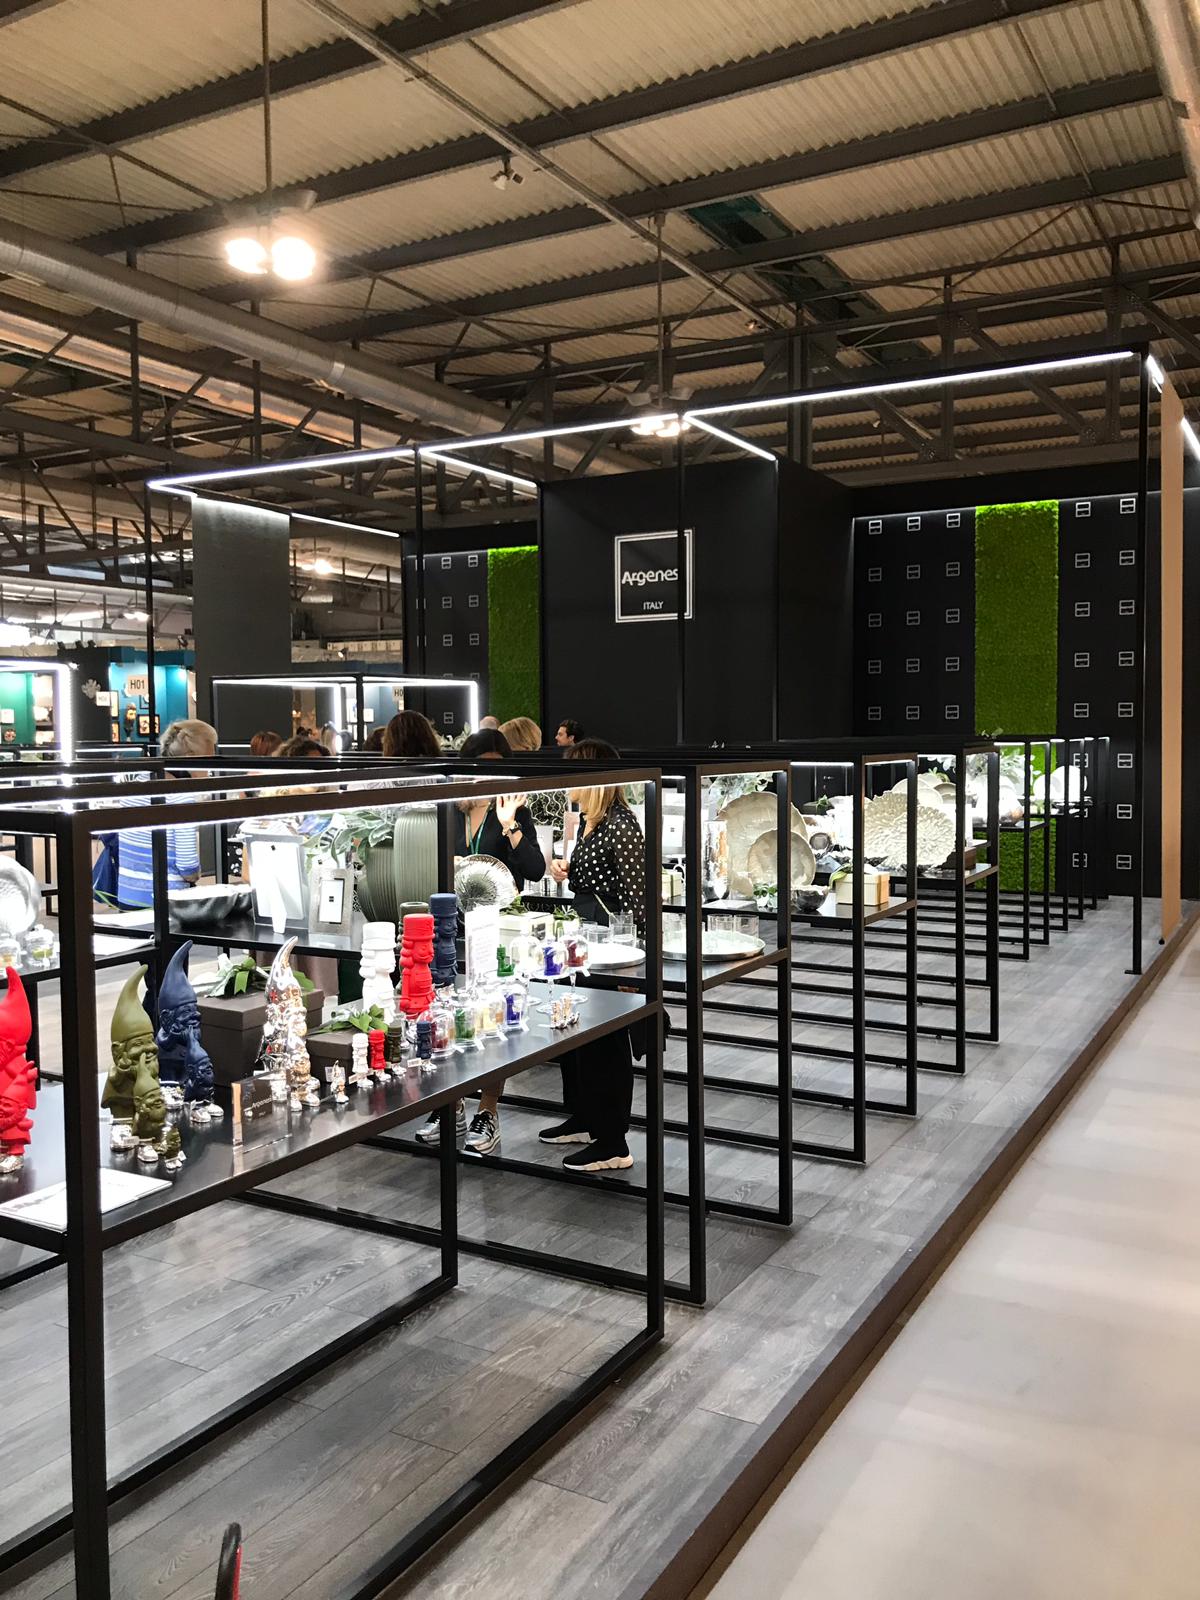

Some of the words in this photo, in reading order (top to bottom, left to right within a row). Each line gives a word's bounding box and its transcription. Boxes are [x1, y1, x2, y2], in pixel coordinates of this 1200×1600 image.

[621, 568, 678, 586] Argenes
[643, 601, 664, 610] ITALY
[130, 680, 145, 690] H01
